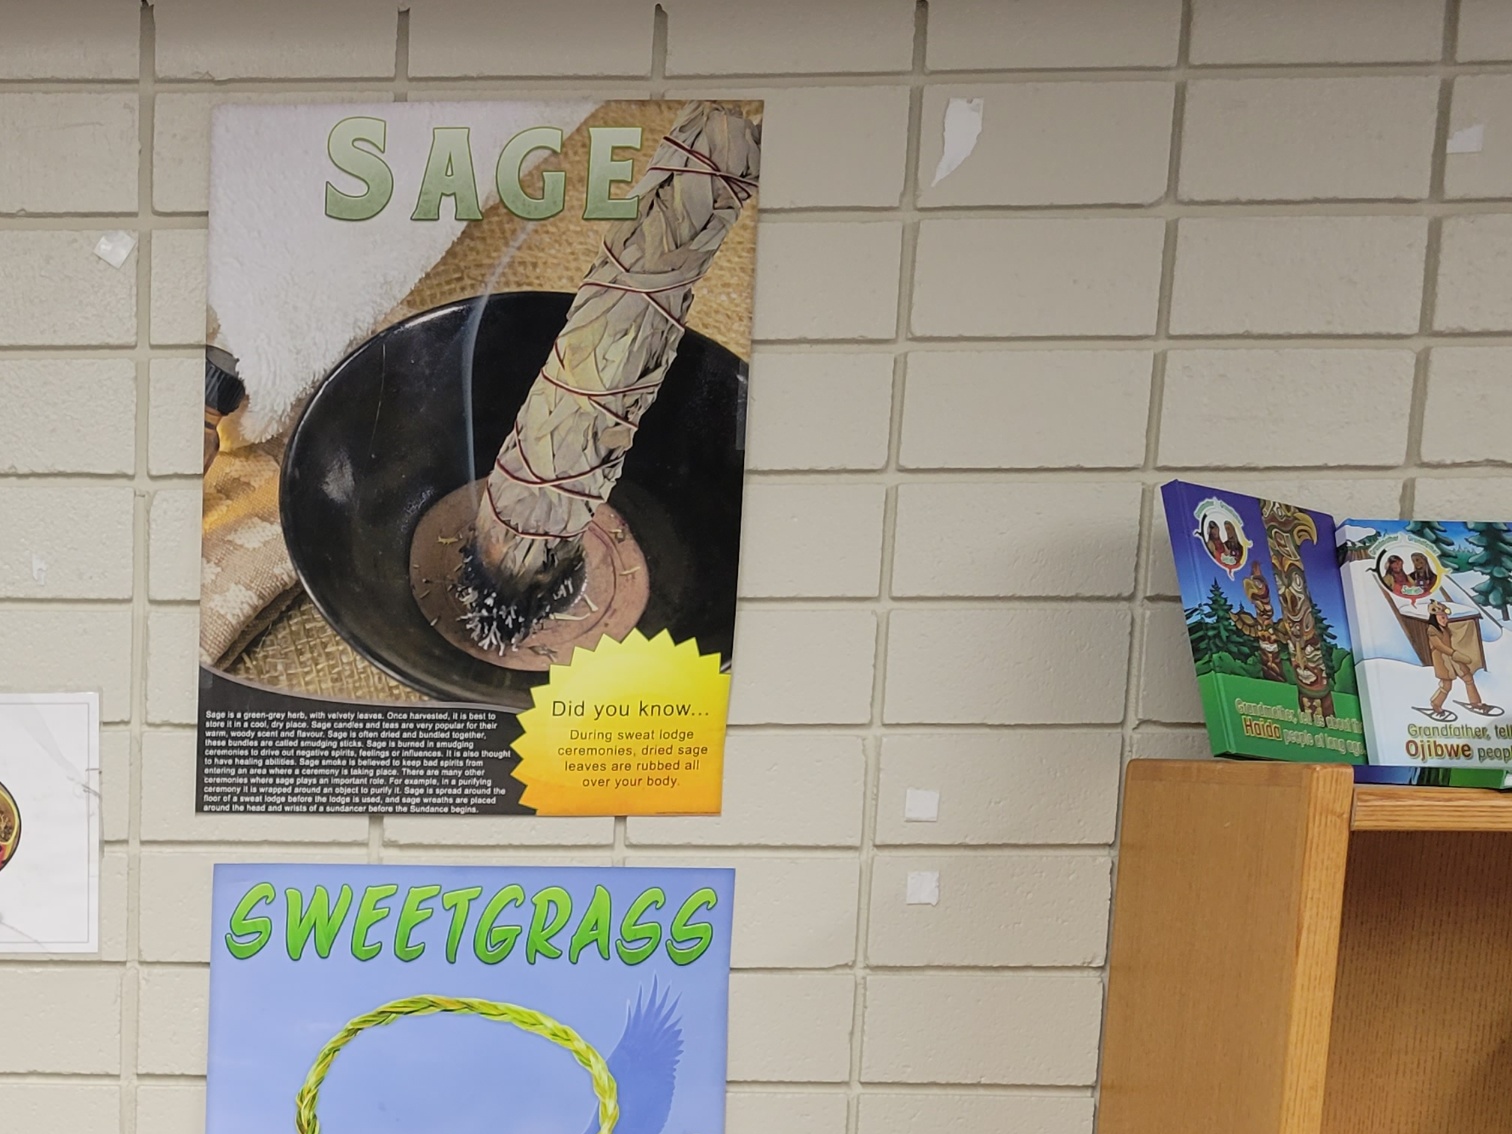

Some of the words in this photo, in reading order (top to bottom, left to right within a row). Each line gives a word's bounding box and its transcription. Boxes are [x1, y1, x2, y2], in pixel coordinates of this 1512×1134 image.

[325, 117, 643, 221] SAGE
[552, 701, 584, 717] Did
[594, 704, 629, 720] you
[638, 700, 709, 716] know...
[570, 729, 612, 743] During
[617, 729, 654, 740] sweat
[659, 728, 694, 742] lodge
[1242, 716, 1282, 740] Haida
[1408, 724, 1491, 740] Grandfather,
[205, 738, 226, 746] these
[227, 738, 258, 746] bundles
[274, 739, 298, 747] called
[300, 739, 337, 749] smudging
[339, 739, 363, 747] sticks.
[366, 739, 386, 750] Sage
[397, 740, 424, 748] burned
[426, 740, 434, 748] in
[436, 740, 474, 750] smudging
[641, 745, 673, 755] dried
[677, 747, 708, 757] sage
[1406, 740, 1473, 762] Ojibwe
[1478, 746, 1512, 763] peop
[564, 761, 606, 771] leaves
[610, 763, 631, 771] are
[636, 760, 680, 771] rubbed
[684, 760, 700, 770] all
[582, 779, 610, 787] over
[614, 778, 642, 789] your
[646, 776, 680, 789] body.
[225, 882, 717, 965] SWEETGRASS
